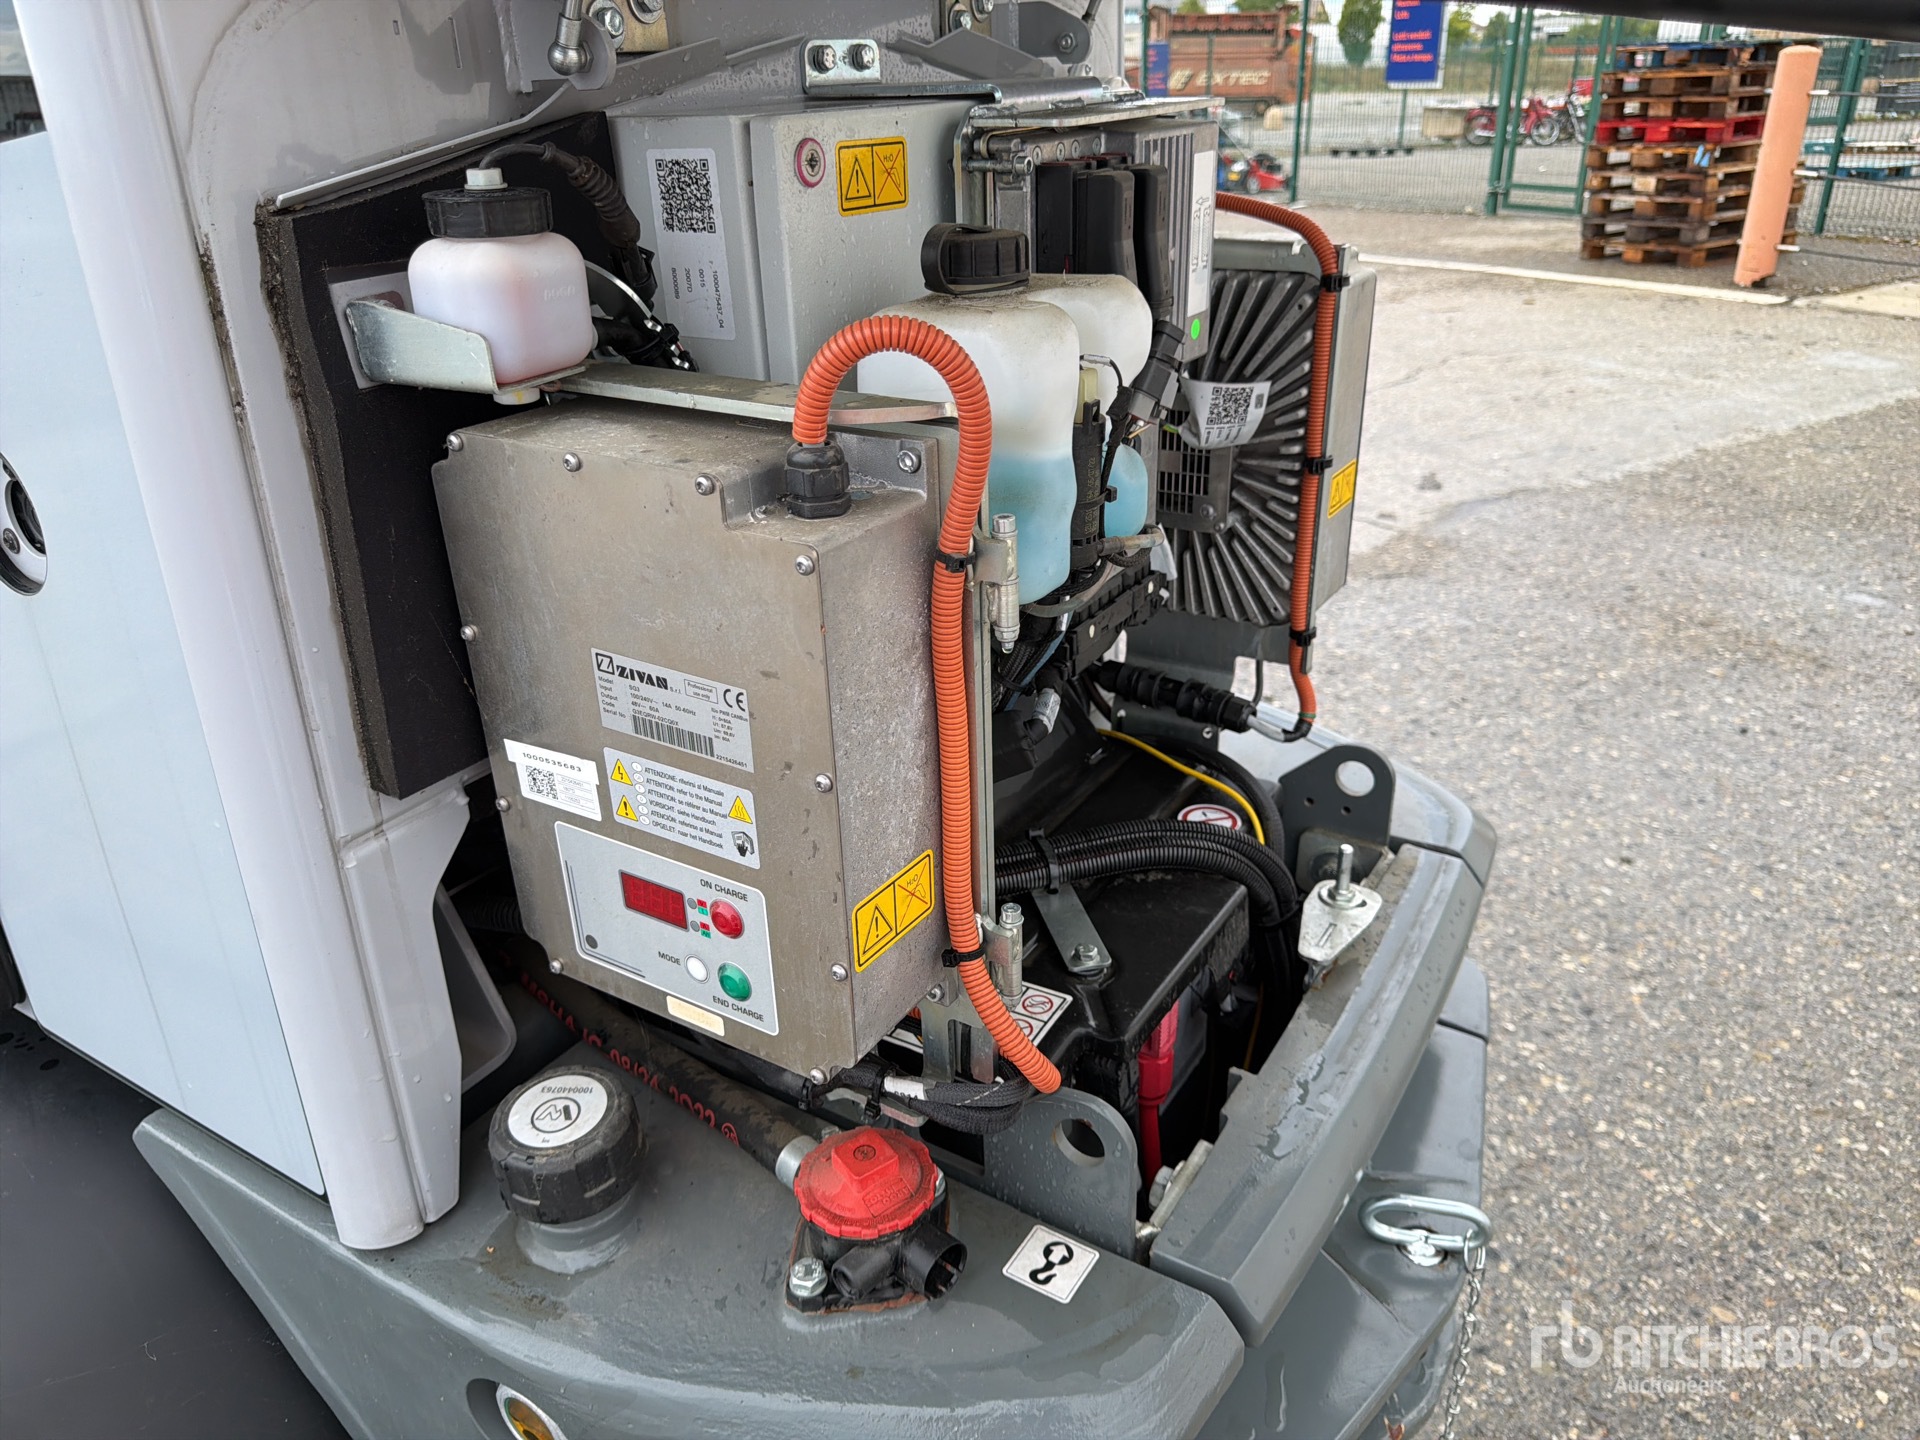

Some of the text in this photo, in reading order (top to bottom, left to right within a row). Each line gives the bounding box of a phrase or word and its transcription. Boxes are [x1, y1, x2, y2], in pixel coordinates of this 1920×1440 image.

[598, 675, 613, 684] Model
[599, 683, 612, 692] Input
[615, 664, 668, 690] ZIVAN
[600, 691, 618, 701] Output
[687, 682, 713, 694] Professional
[701, 692, 710, 700] only
[601, 699, 614, 707] Code
[602, 707, 617, 716] Serial
[522, 751, 581, 772] 1000535683
[643, 766, 678, 782] ATTENZIONE:
[702, 784, 724, 797] Manuale
[645, 777, 676, 792] ATTENTION:
[675, 786, 688, 796] refer
[688, 790, 694, 798] to
[694, 792, 703, 801] the
[703, 795, 722, 807] Manual
[646, 788, 677, 803] ATTENTION:
[708, 807, 727, 820] Manuel
[648, 799, 676, 813] VORSICHT:
[676, 807, 690, 818] siehe
[690, 812, 716, 826] Handbuch
[649, 808, 677, 824] ATENCIÓN:
[704, 827, 722, 839] Manual
[651, 819, 677, 834] OPGELET:
[677, 828, 689, 838] naar
[689, 832, 698, 841] het
[698, 834, 723, 849] Handboek
[699, 878, 748, 902] ON CHARGE
[657, 950, 680, 965] MODE
[712, 995, 764, 1022] END CHARGE
[541, 1086, 594, 1094] 1000440763
